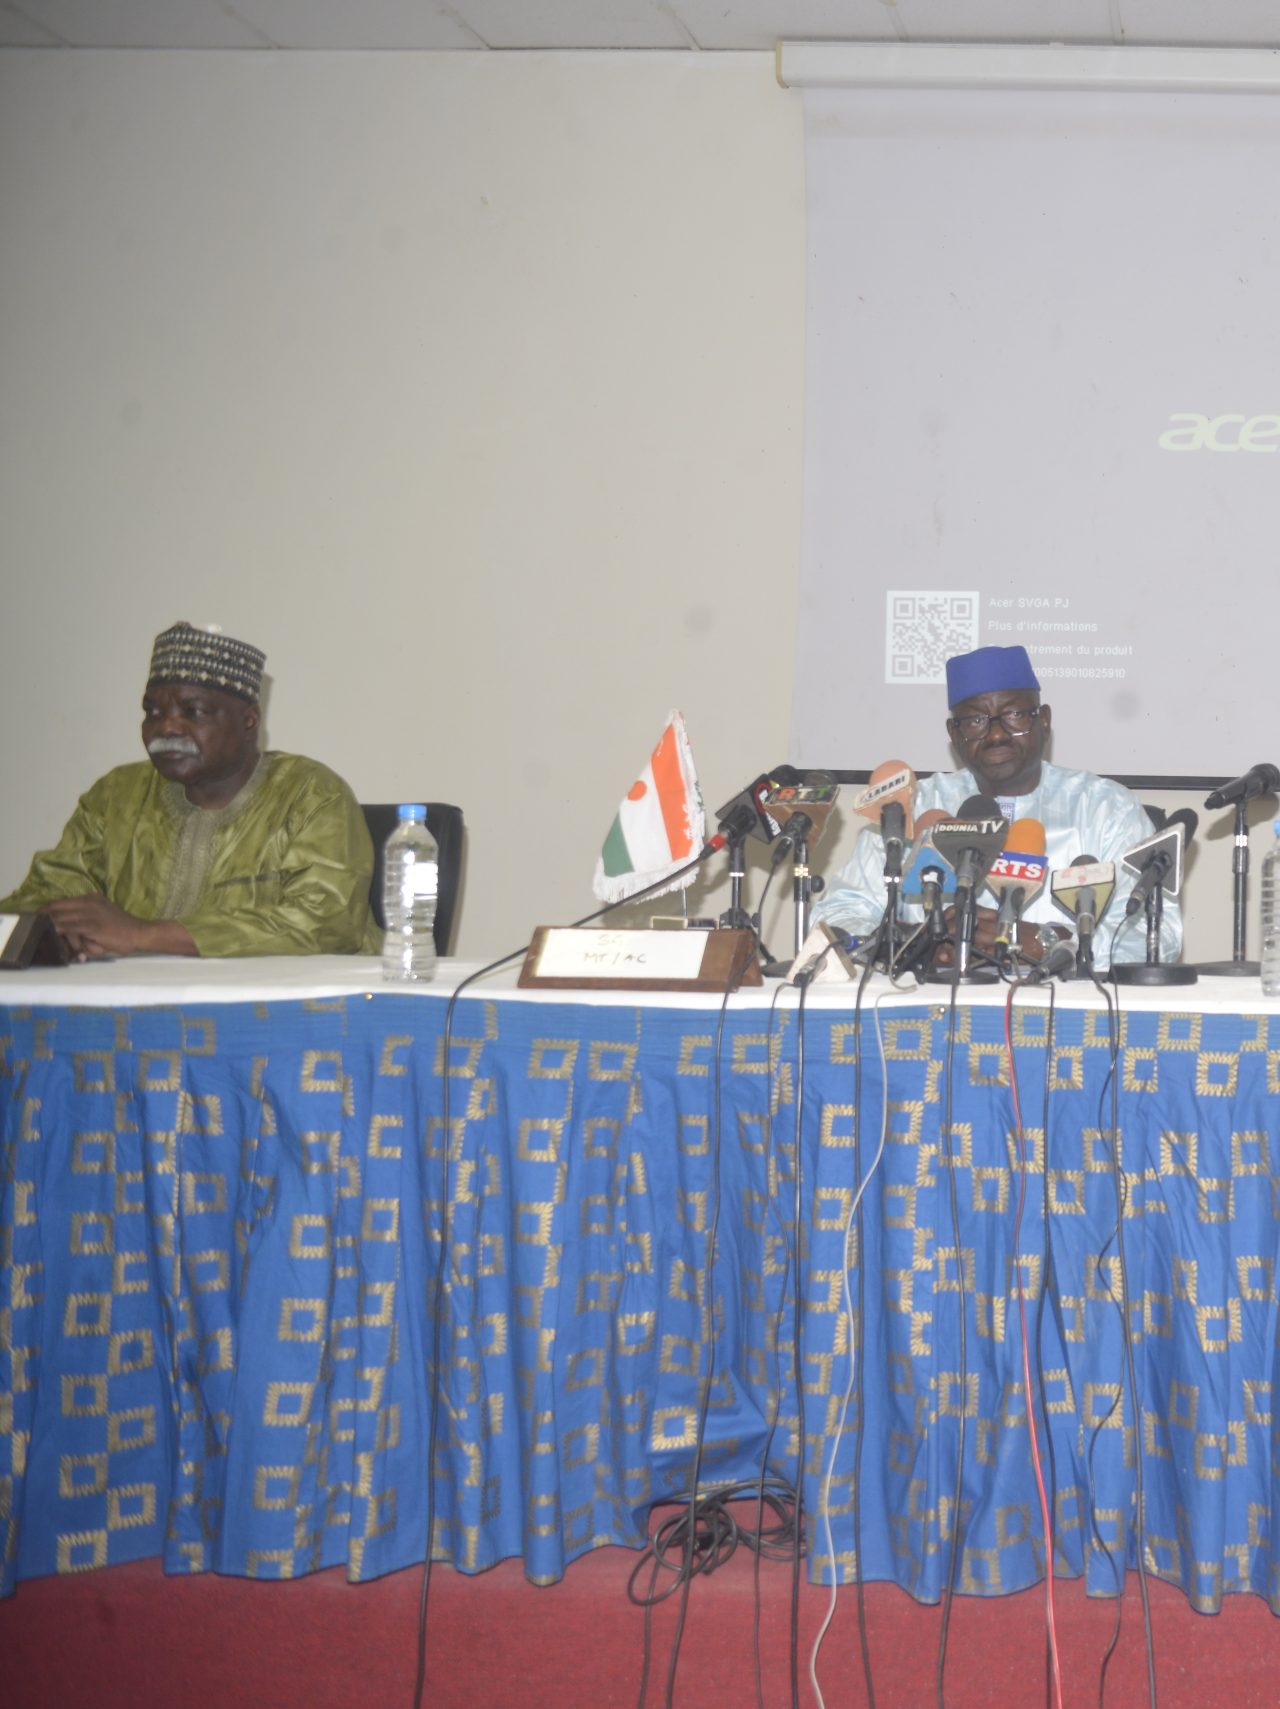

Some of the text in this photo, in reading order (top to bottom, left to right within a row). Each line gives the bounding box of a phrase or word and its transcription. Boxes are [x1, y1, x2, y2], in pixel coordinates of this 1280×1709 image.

[988, 597, 1070, 609] Acer SVGA PJ
[988, 619, 1098, 632] Plus d'informations
[1077, 645, 1090, 655] du
[1094, 645, 1133, 657] produit
[980, 820, 1004, 834] TV
[990, 858, 1043, 879] RTS
